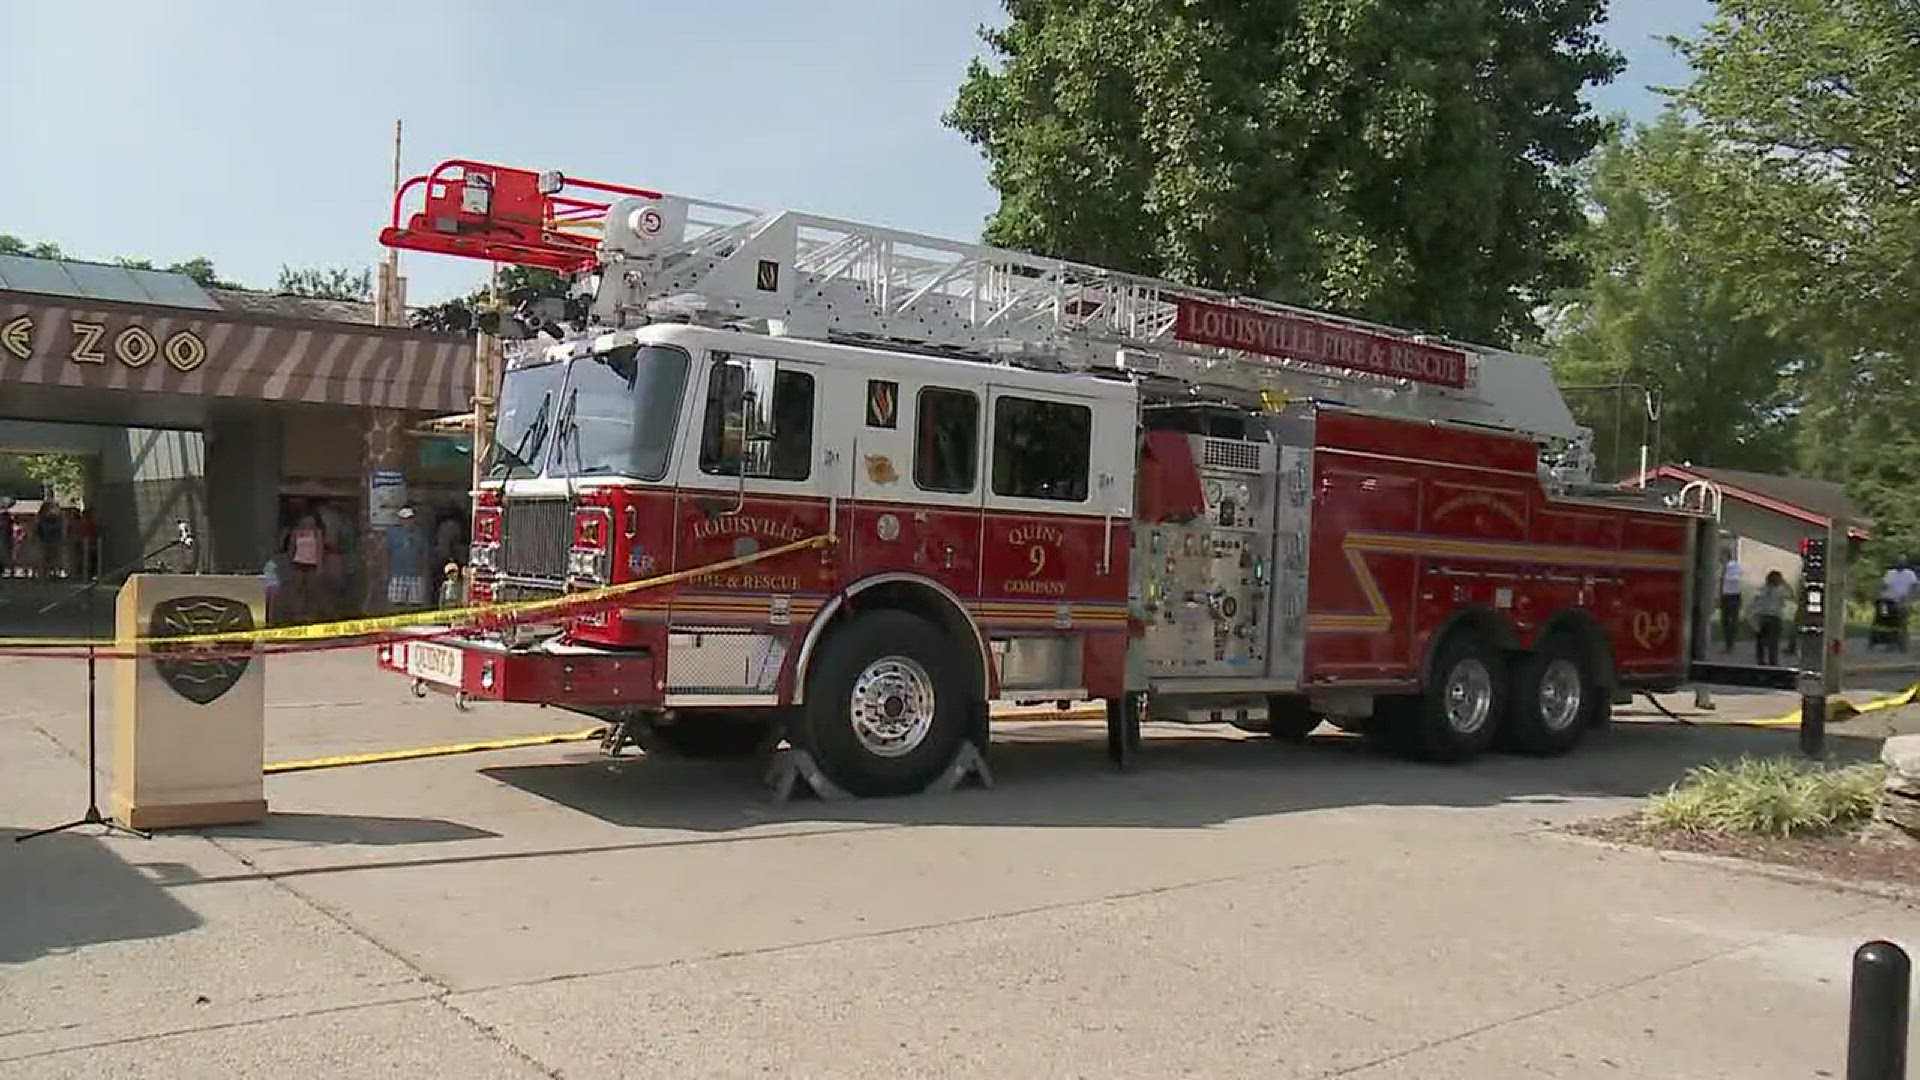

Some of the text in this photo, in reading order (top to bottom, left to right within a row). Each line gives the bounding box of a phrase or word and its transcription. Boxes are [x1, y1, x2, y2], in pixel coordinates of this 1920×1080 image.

[70, 320, 208, 373] ZOO
[1188, 304, 1459, 382] LOUISVILLE FIRE & RESCUE
[693, 516, 804, 542] LOUISVILLE
[1008, 525, 1065, 547] QUINT
[1029, 545, 1046, 577] 9
[726, 575, 738, 590] &
[744, 575, 801, 591] RESCUE
[1004, 580, 1067, 595] COMPANY
